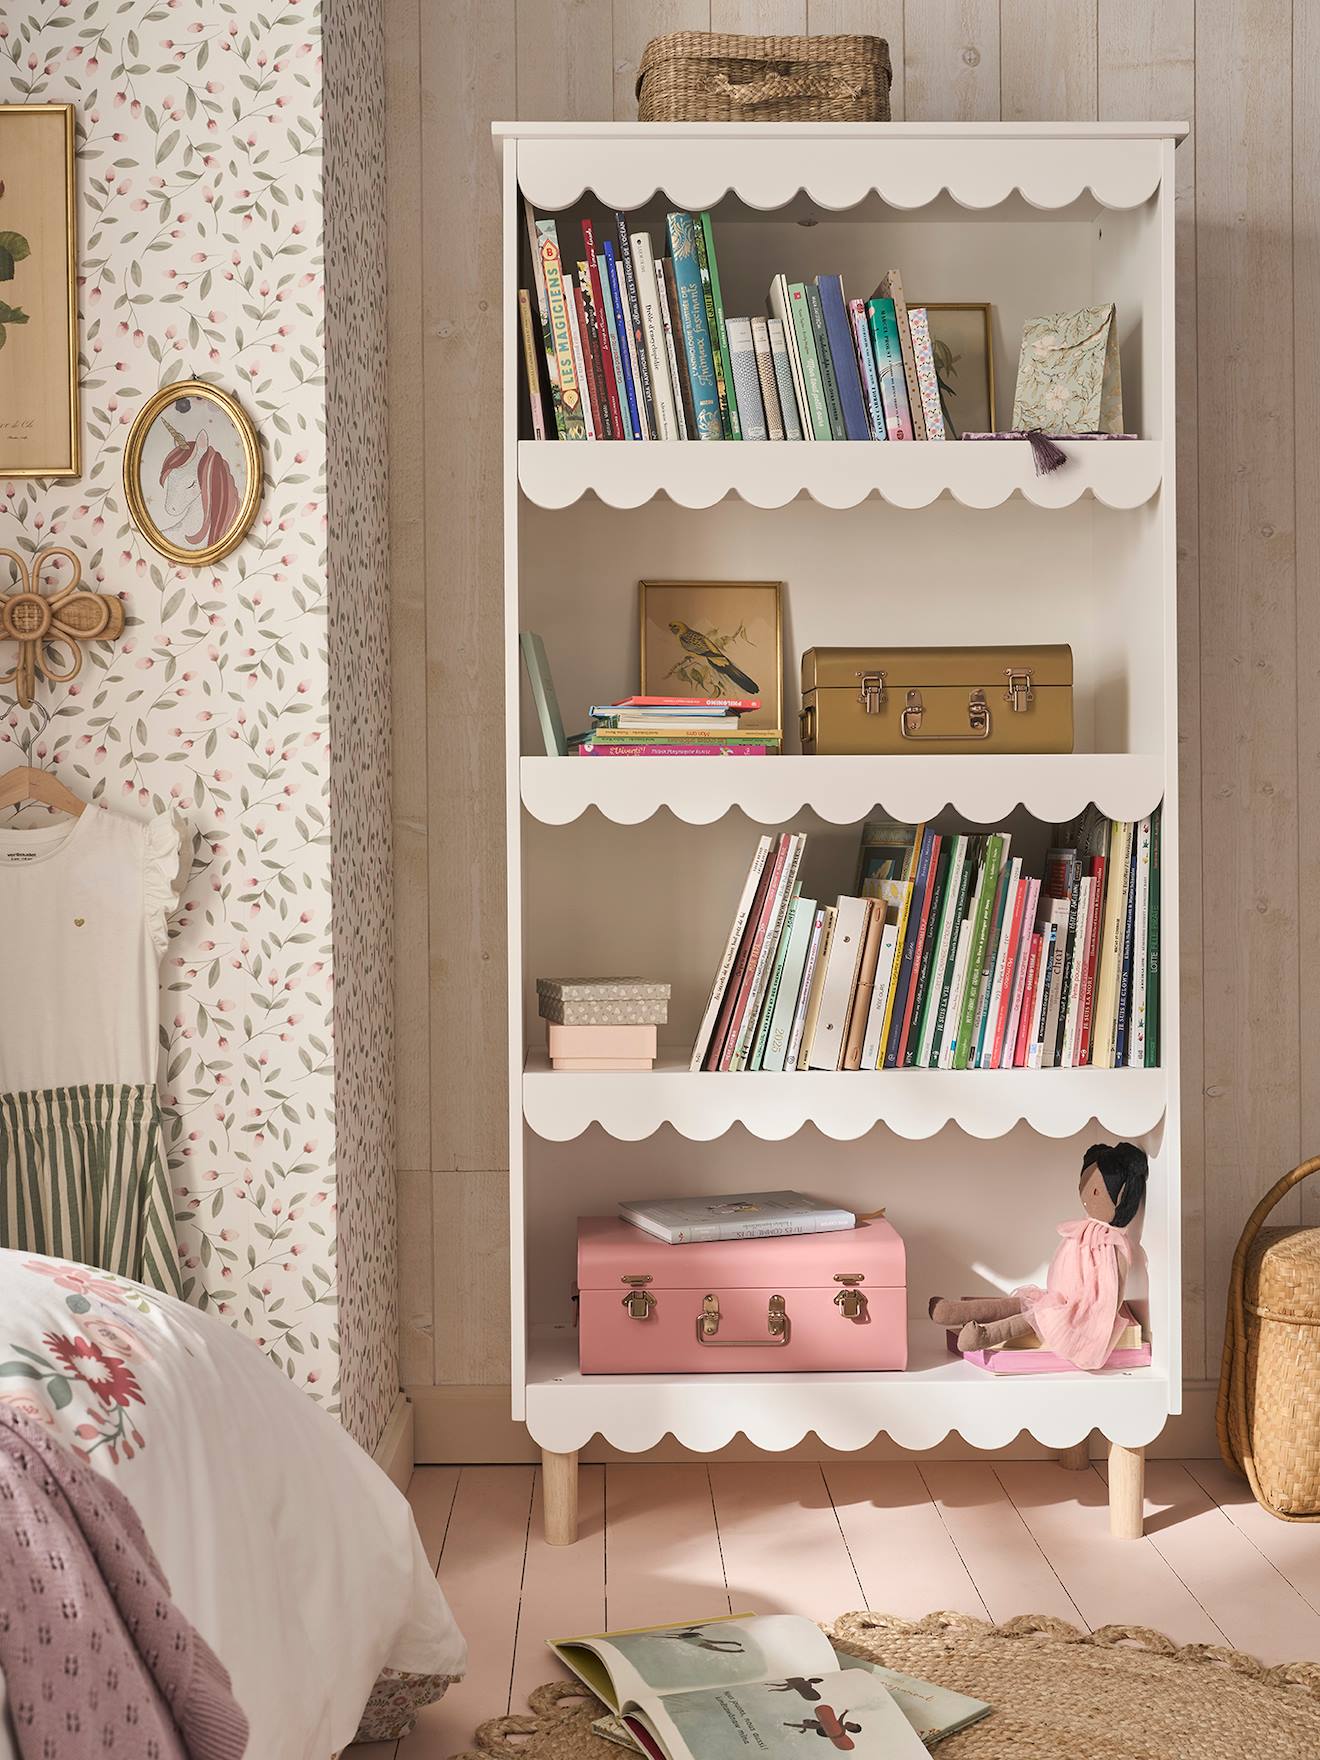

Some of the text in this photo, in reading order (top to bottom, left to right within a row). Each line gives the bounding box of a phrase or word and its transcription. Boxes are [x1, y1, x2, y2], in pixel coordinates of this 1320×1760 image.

[622, 246, 629, 255] DE
[629, 294, 636, 302] ET
[545, 267, 574, 384] LES MAGICIENS
[686, 282, 713, 386] Animaux fascinants
[638, 348, 652, 401] LARA HAWTHORNE
[705, 698, 741, 707] PHILONIMO
[1051, 948, 1062, 974] chat
[1149, 951, 1158, 972] LOTTE
[1024, 953, 1037, 991] PHILONIMO
[1071, 982, 1079, 999] Petite
[1085, 976, 1093, 995] MORT
[1120, 970, 1128, 996] CLOWN
[937, 984, 950, 1031] JE SUIS LA VIE
[1085, 995, 1091, 1005] LA
[1119, 996, 1126, 1006] LE
[1082, 1021, 1089, 1029] JE
[770, 1027, 786, 1053] 2025
